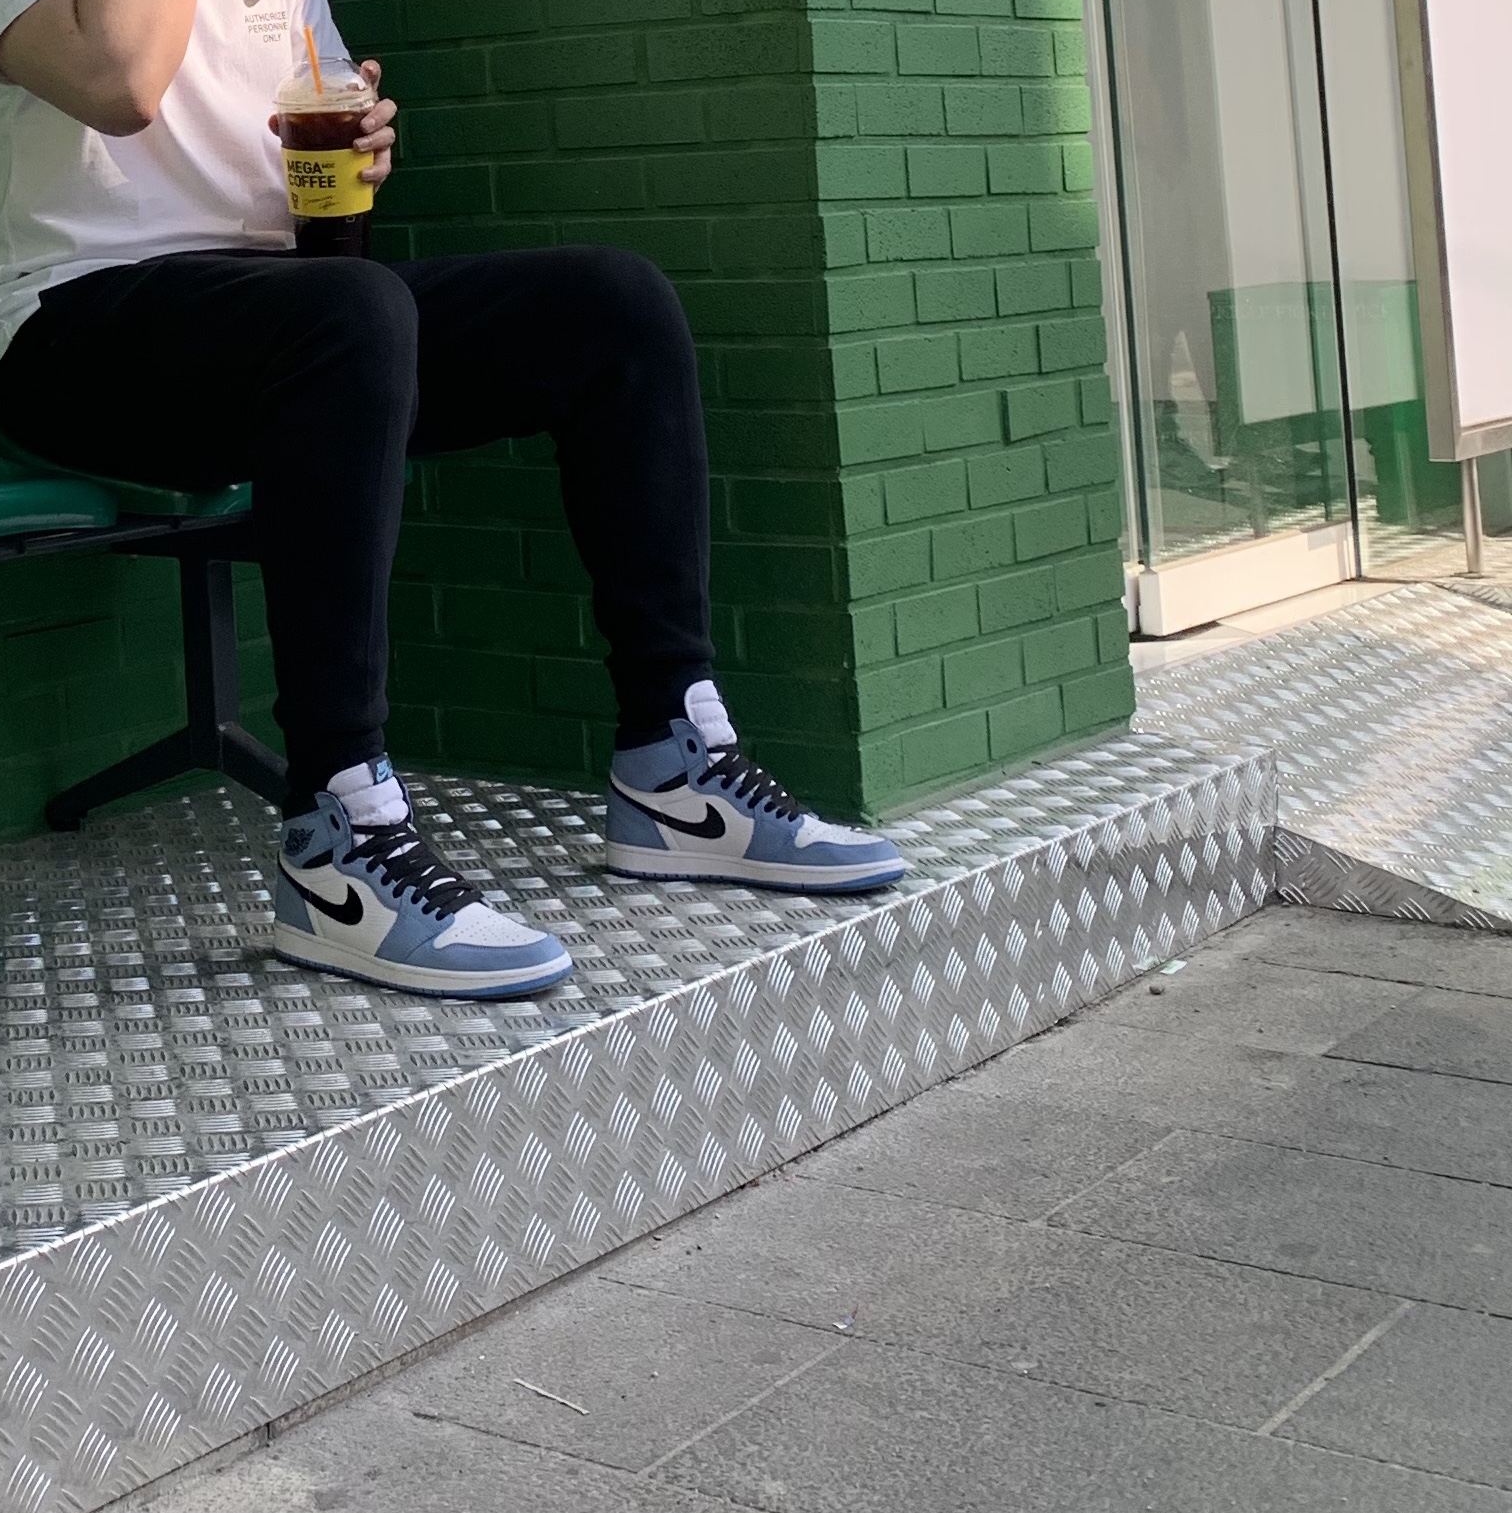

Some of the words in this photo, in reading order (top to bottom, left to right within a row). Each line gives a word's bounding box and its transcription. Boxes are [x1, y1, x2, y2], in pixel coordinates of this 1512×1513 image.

[263, 33, 282, 44] ONLY
[287, 159, 323, 174] MEGA
[288, 174, 337, 189] COFFEE
